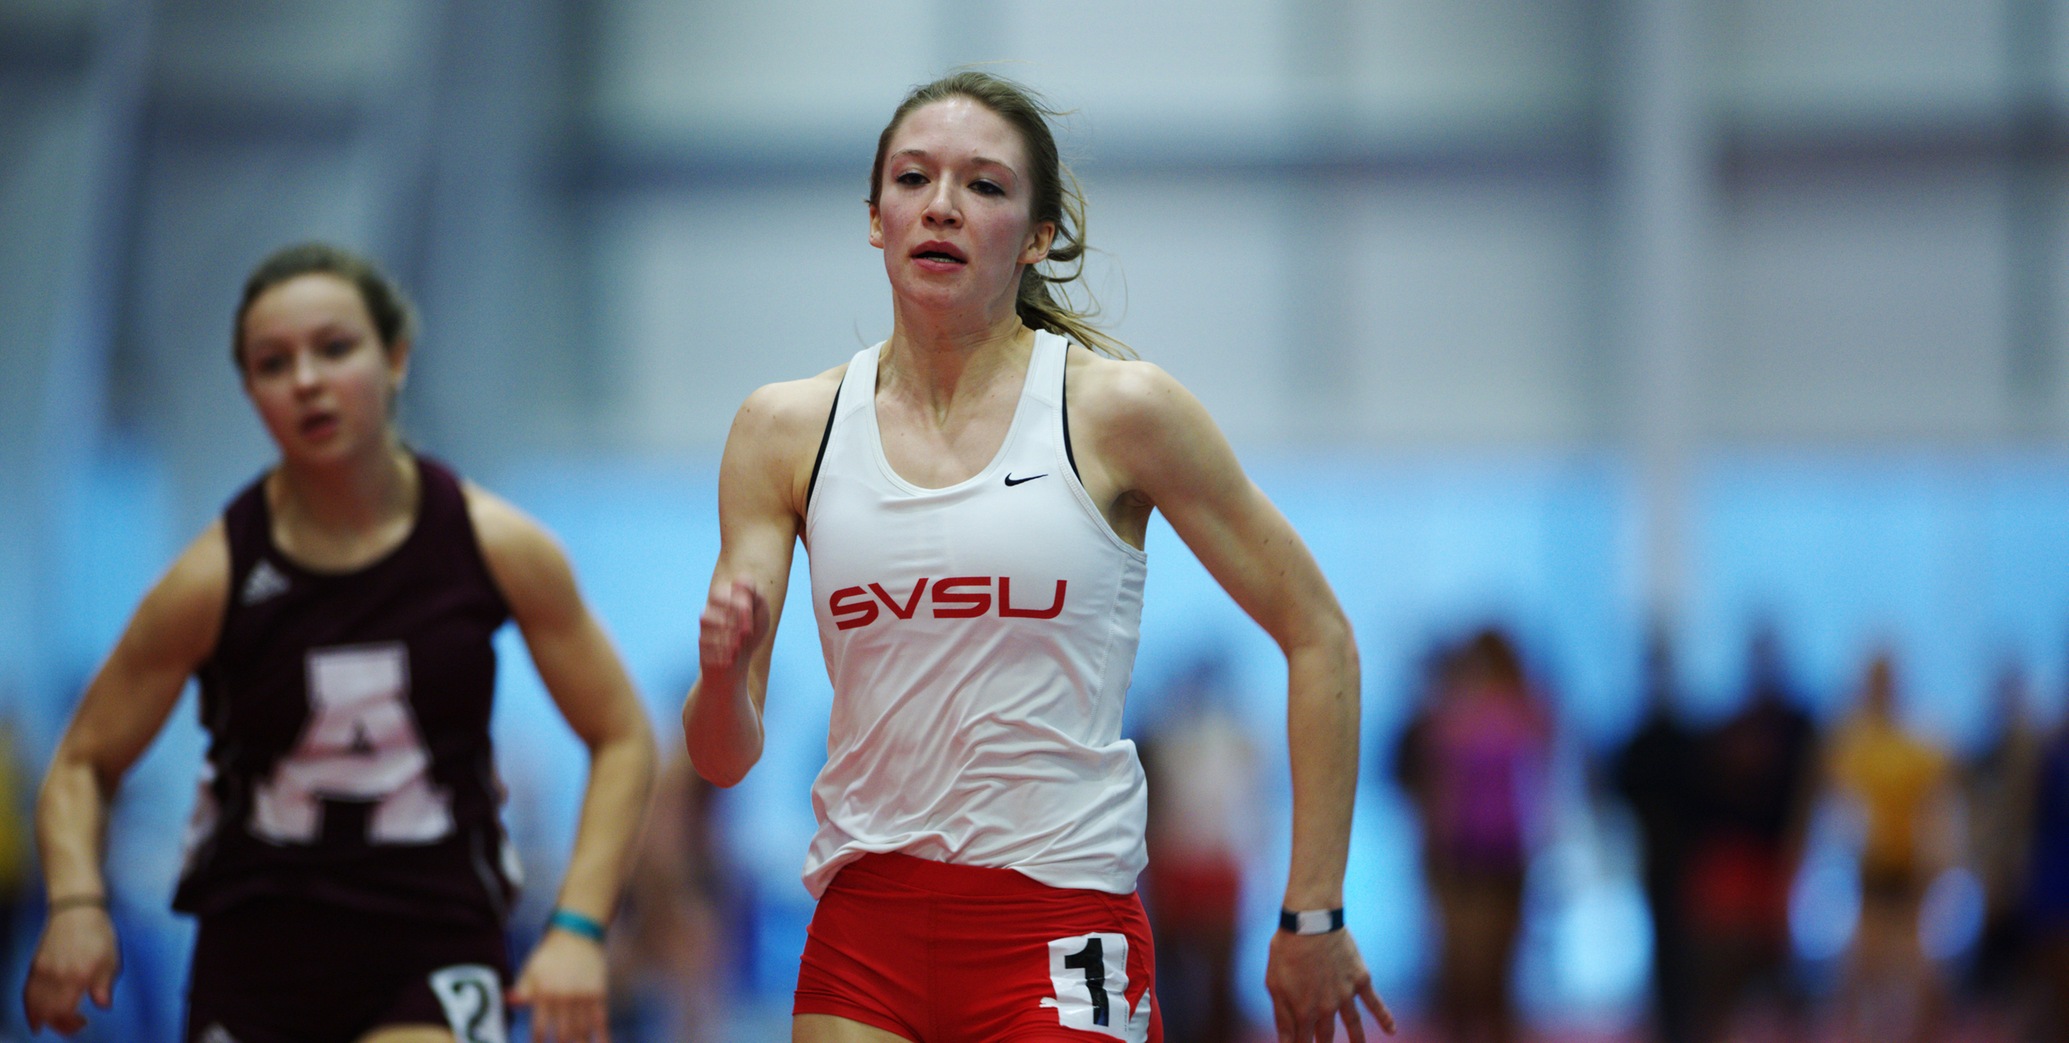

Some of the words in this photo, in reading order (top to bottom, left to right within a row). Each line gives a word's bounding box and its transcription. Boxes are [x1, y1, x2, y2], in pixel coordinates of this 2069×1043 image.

[829, 576, 1067, 631] SVSU
[254, 646, 453, 843] A
[452, 979, 490, 1043] 2
[1064, 937, 1109, 1027] 1
